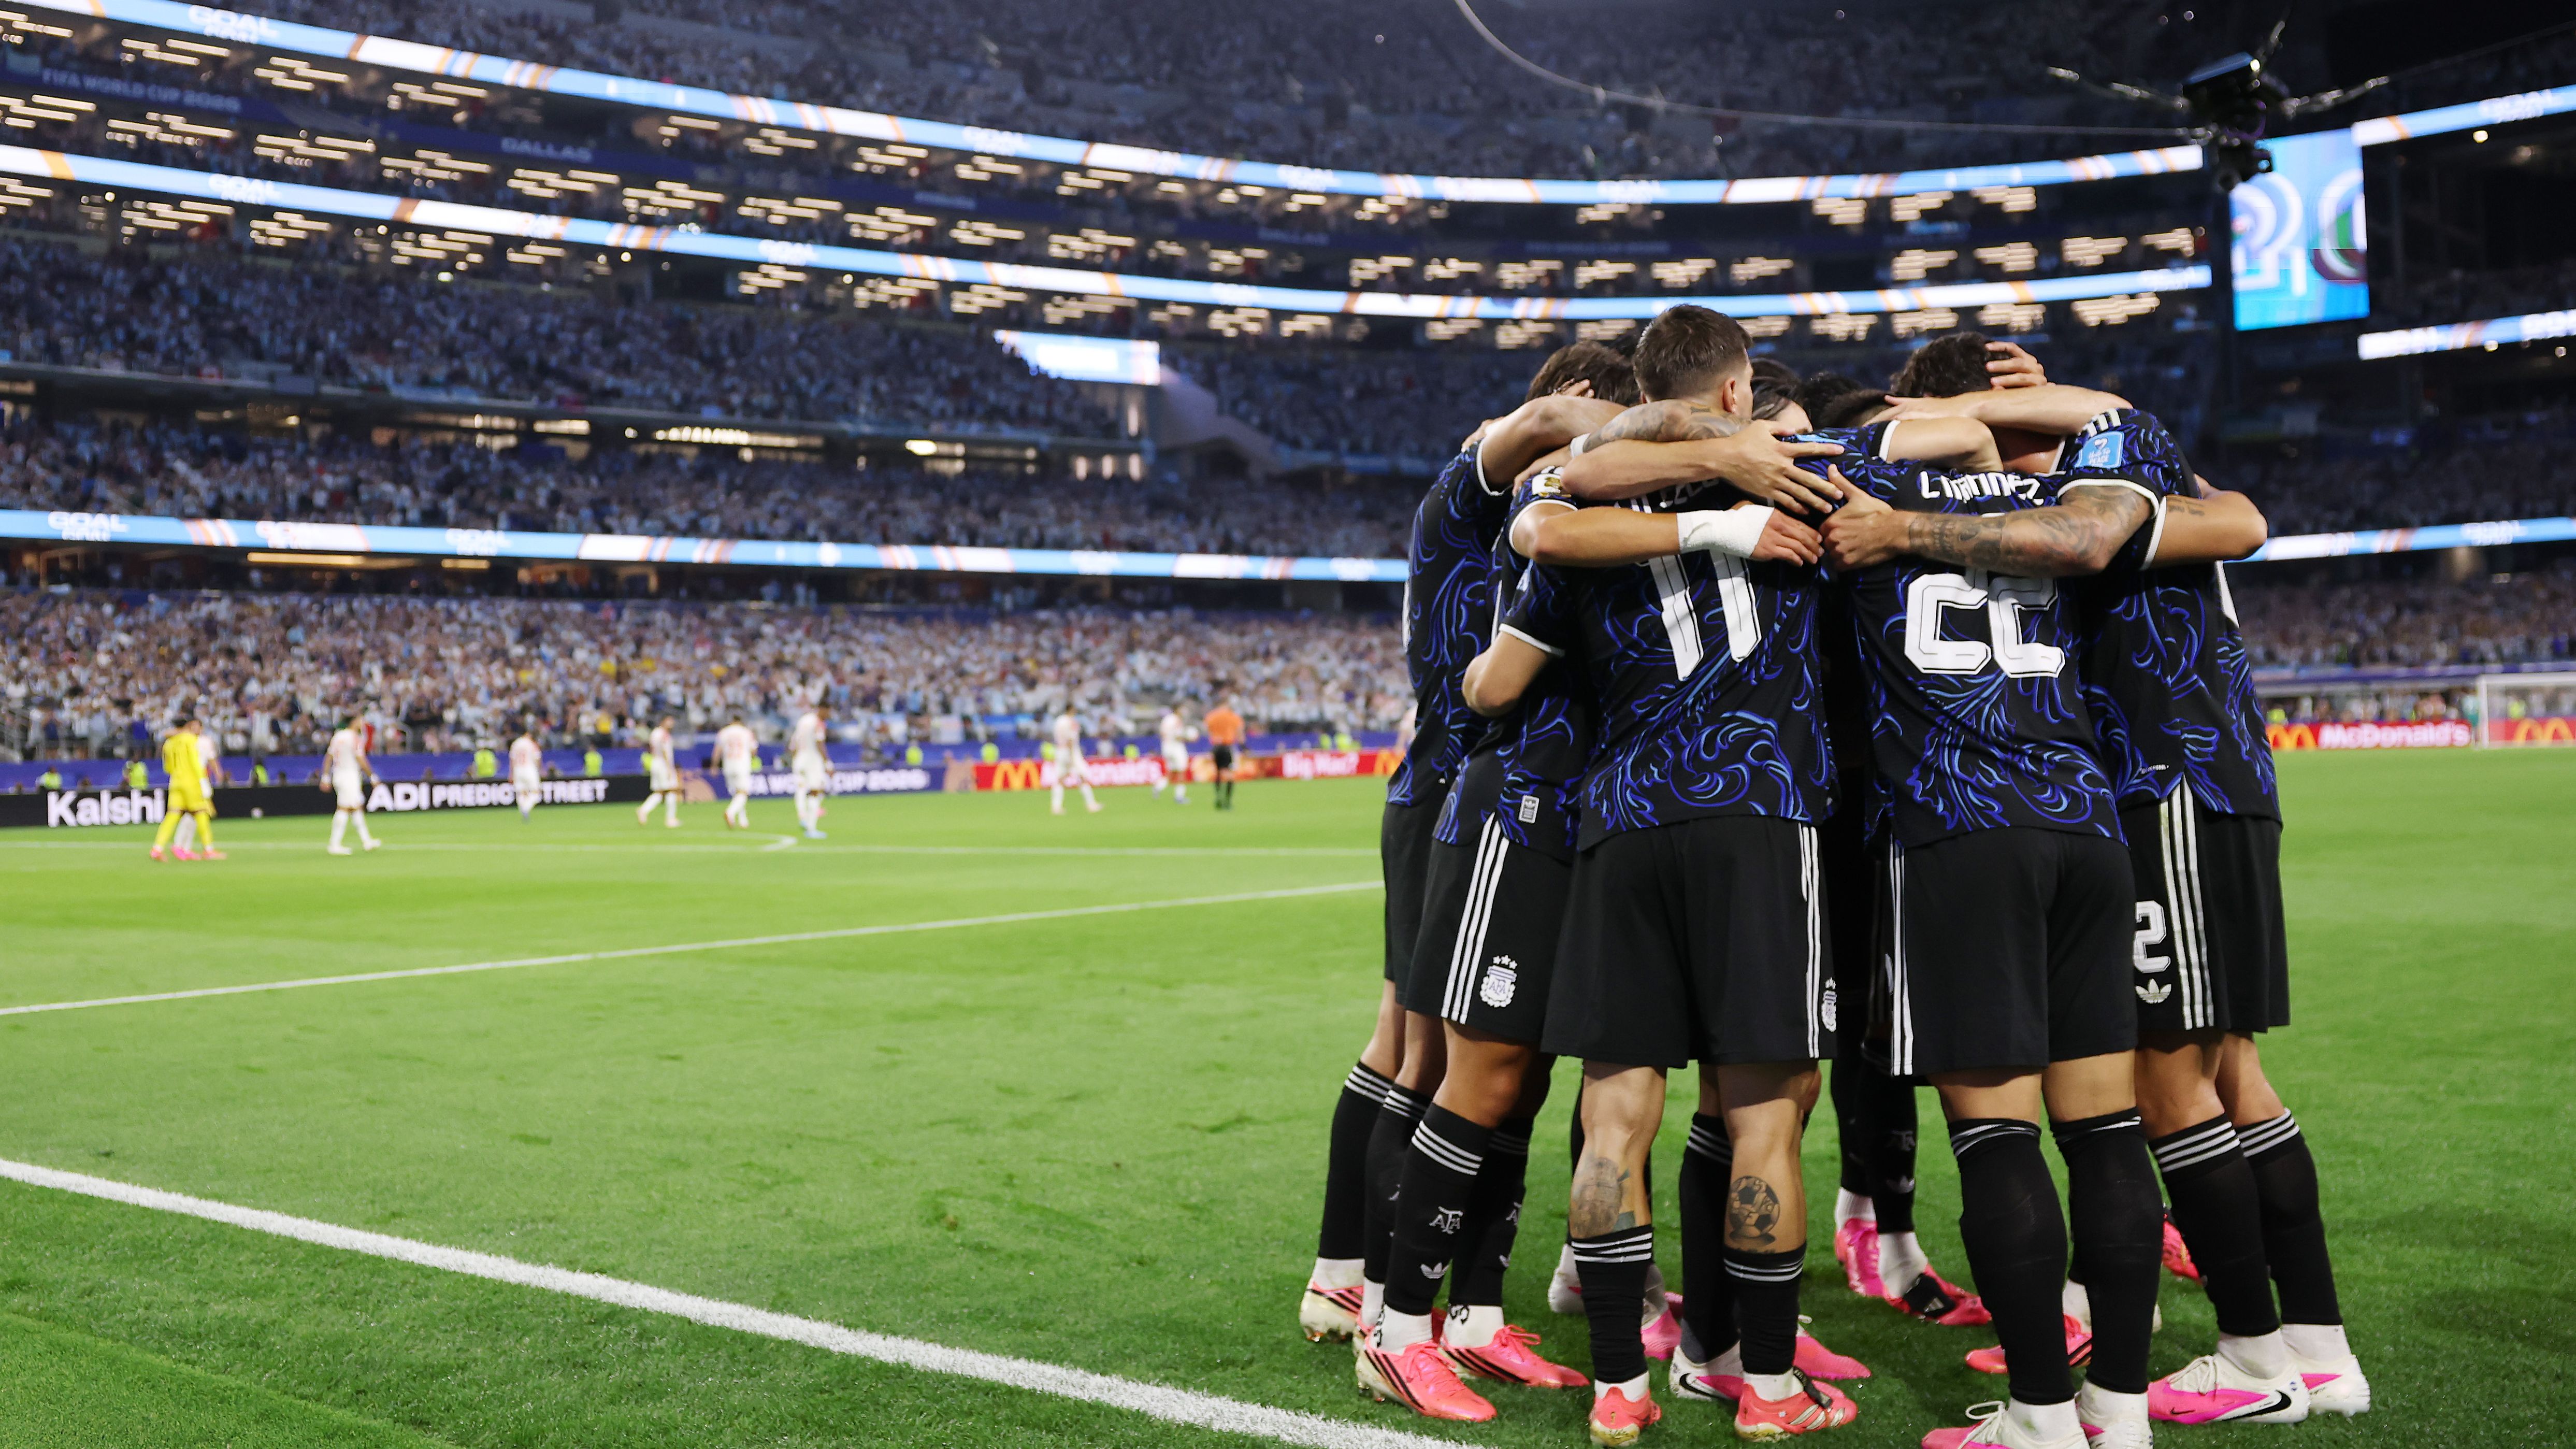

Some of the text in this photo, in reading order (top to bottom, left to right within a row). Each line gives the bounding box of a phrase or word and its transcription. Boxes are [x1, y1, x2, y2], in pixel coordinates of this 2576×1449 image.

[189, 5, 280, 38] GOAL
[48, 511, 129, 532] GOAL
[1647, 549, 1762, 681] 11
[2318, 722, 2471, 749] McDonald's
[1282, 751, 1314, 780] Big
[47, 779, 609, 827] Kalshi ADI PREDICTREET
[1429, 1206, 1463, 1235] AFA
